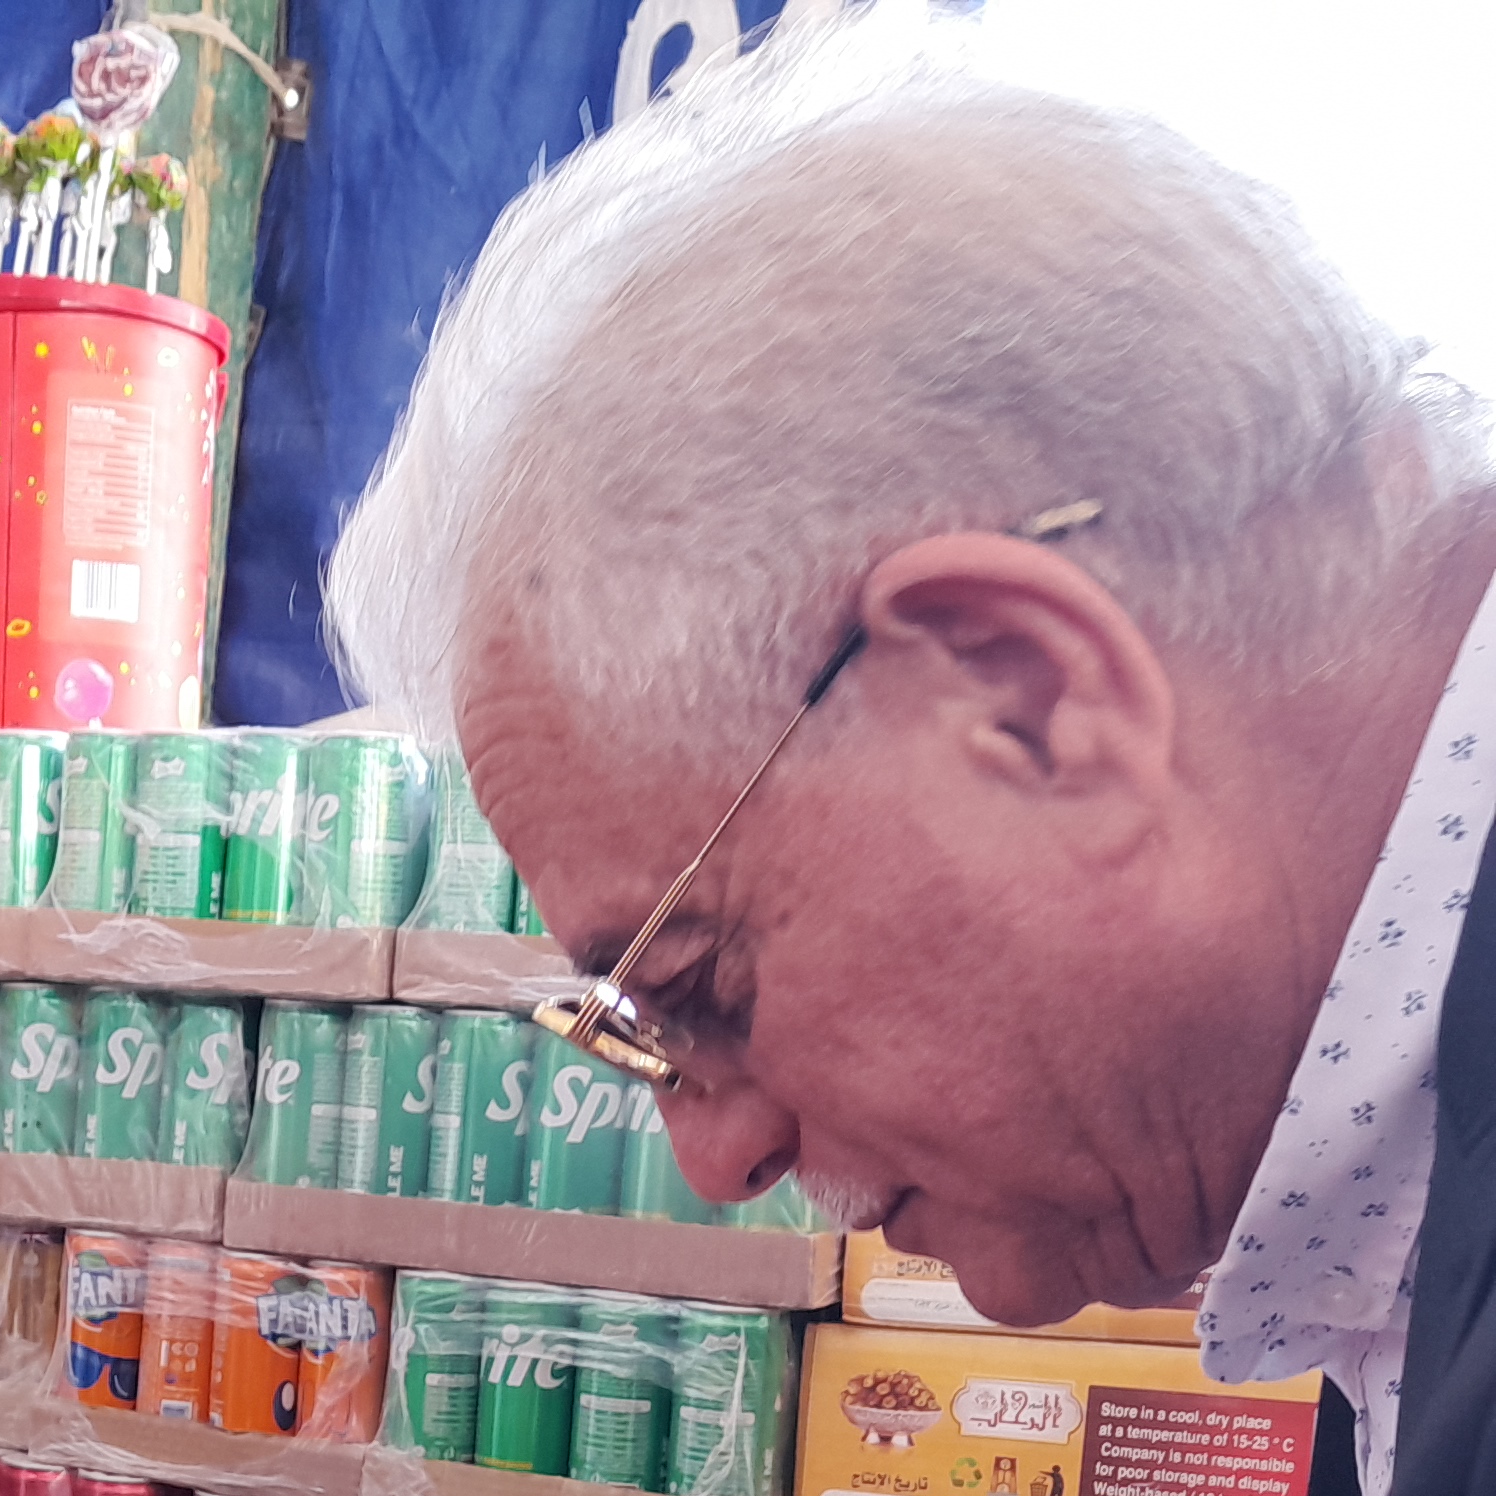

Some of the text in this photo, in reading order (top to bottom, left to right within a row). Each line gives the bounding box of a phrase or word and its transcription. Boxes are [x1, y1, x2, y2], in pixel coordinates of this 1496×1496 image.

[1101, 1402, 1272, 1430] Store in a cool, dry place
[1099, 1424, 1295, 1452] at a temperature of 15-25 C
[1101, 1442, 1295, 1473] Company is not responsible
[1095, 1462, 1290, 1496] for poor storage and display
